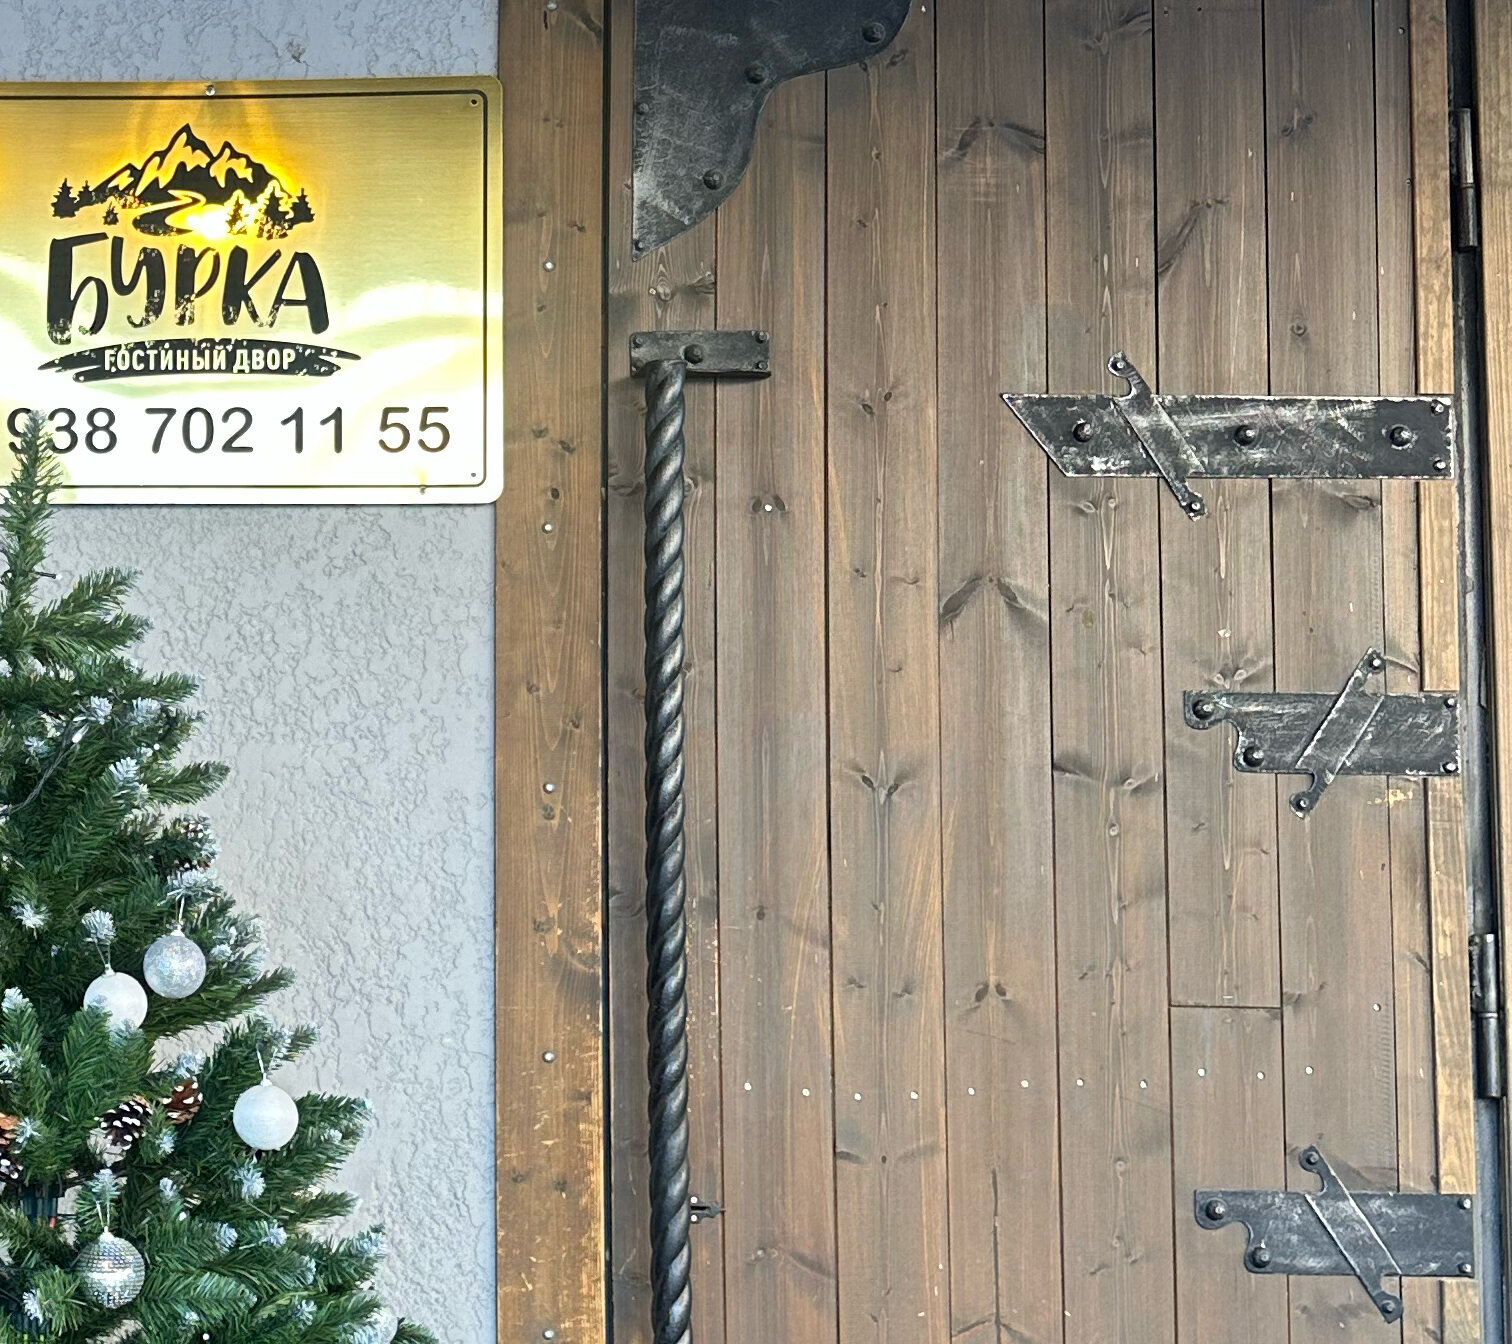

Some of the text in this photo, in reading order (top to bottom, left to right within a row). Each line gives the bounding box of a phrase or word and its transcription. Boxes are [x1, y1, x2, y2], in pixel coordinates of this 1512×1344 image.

[104, 344, 296, 373] ГОСТИНЫЙ ДВОР
[145, 406, 254, 454] 702
[281, 406, 343, 454] 11
[378, 406, 450, 453] 55
